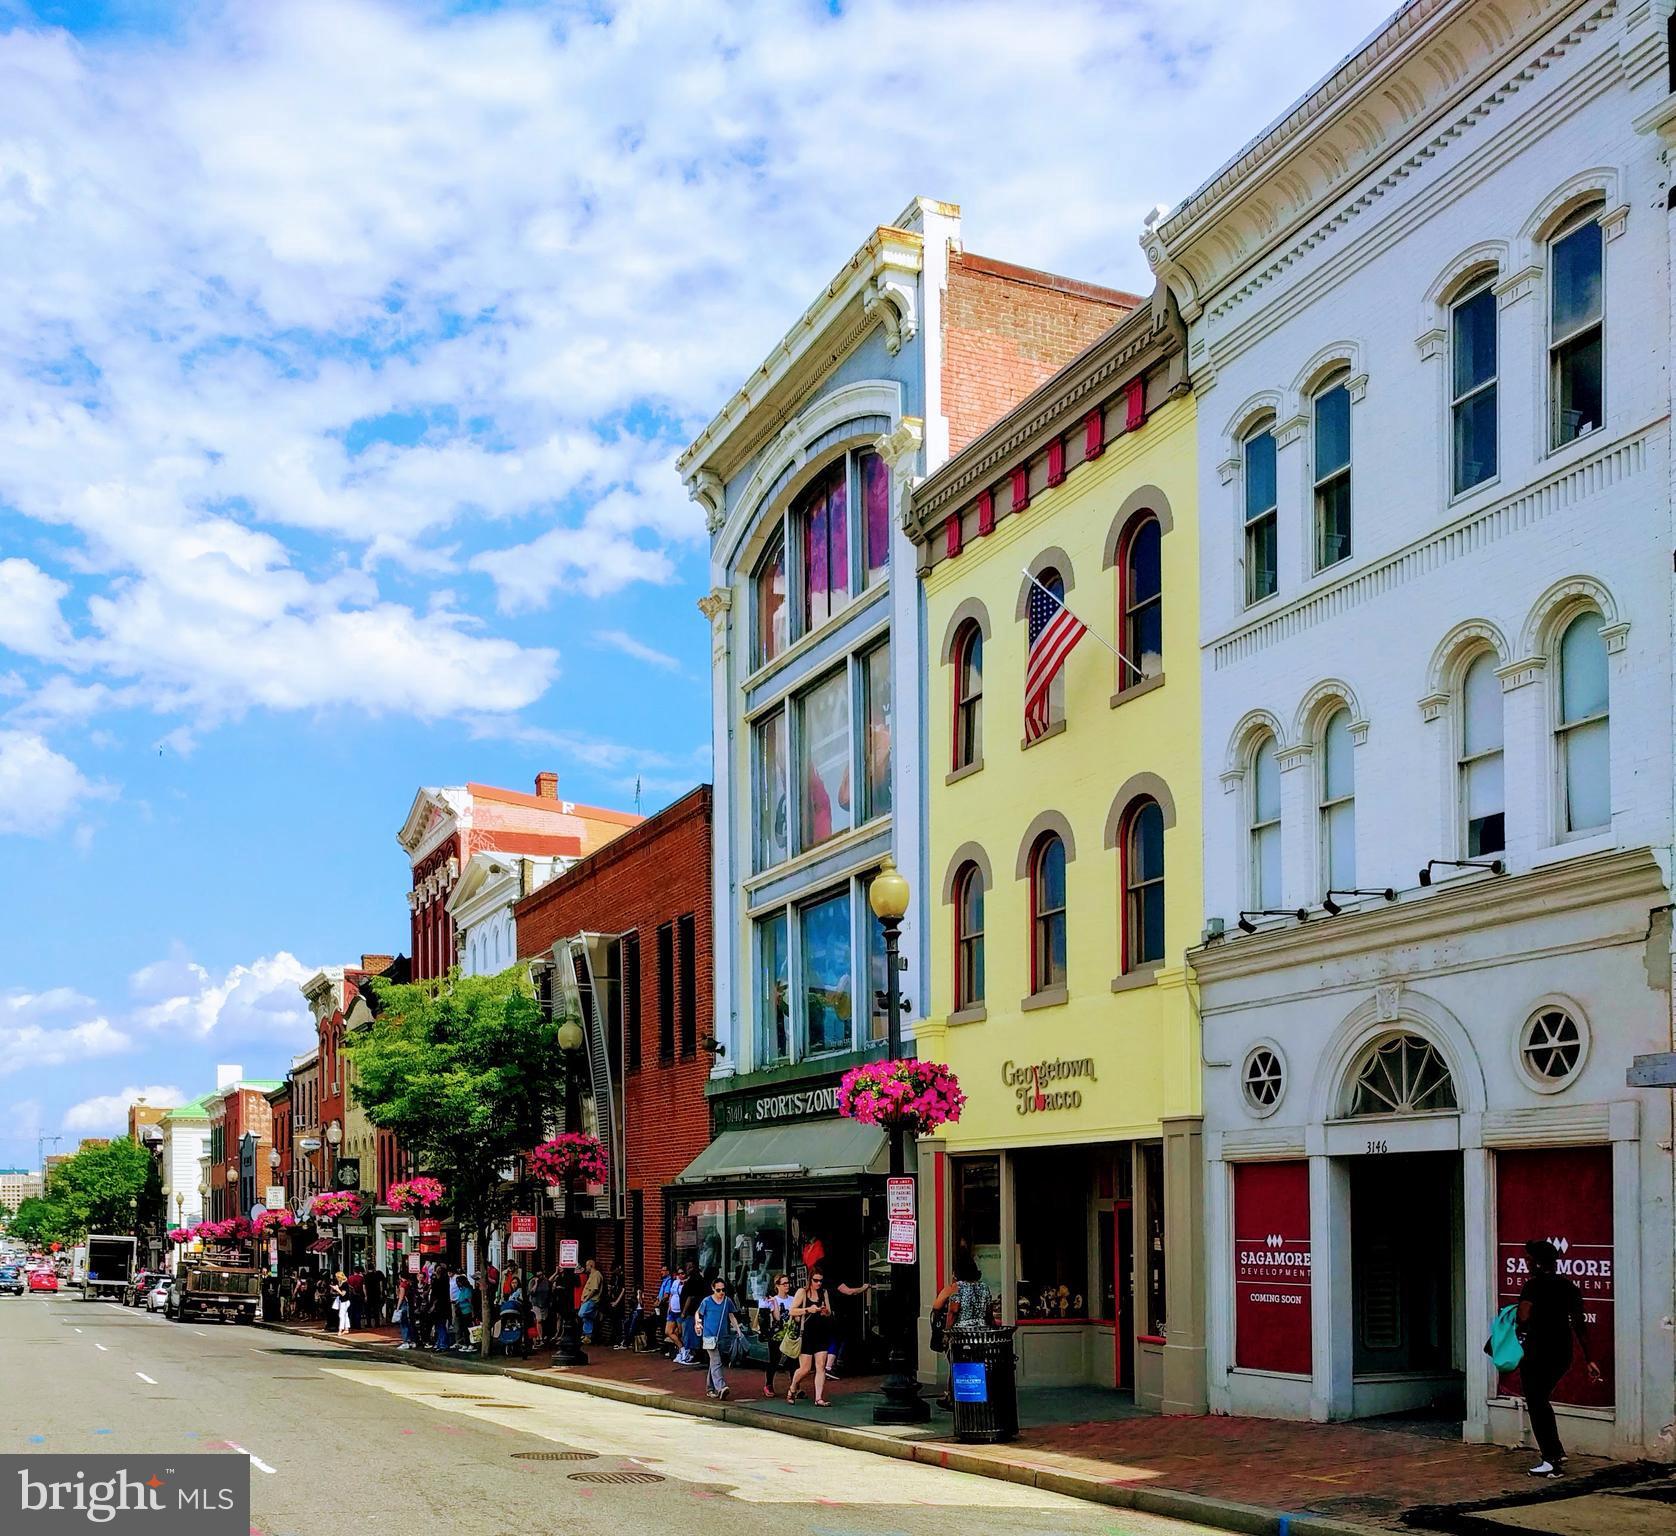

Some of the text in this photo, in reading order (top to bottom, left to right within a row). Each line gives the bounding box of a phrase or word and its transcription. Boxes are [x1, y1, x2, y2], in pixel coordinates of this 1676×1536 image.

[1001, 1057, 1098, 1088] Georgetown
[756, 1093, 803, 1120] SPORTS
[1015, 1085, 1082, 1115] Tobacco
[1366, 1139, 1388, 1154] 3146
[1240, 1251, 1311, 1266] SAGAMORE
[1506, 1257, 1612, 1277] SAMORE
[1240, 1267, 1312, 1277] DEVELOPMENT
[1250, 1293, 1302, 1305] COMING SOON
